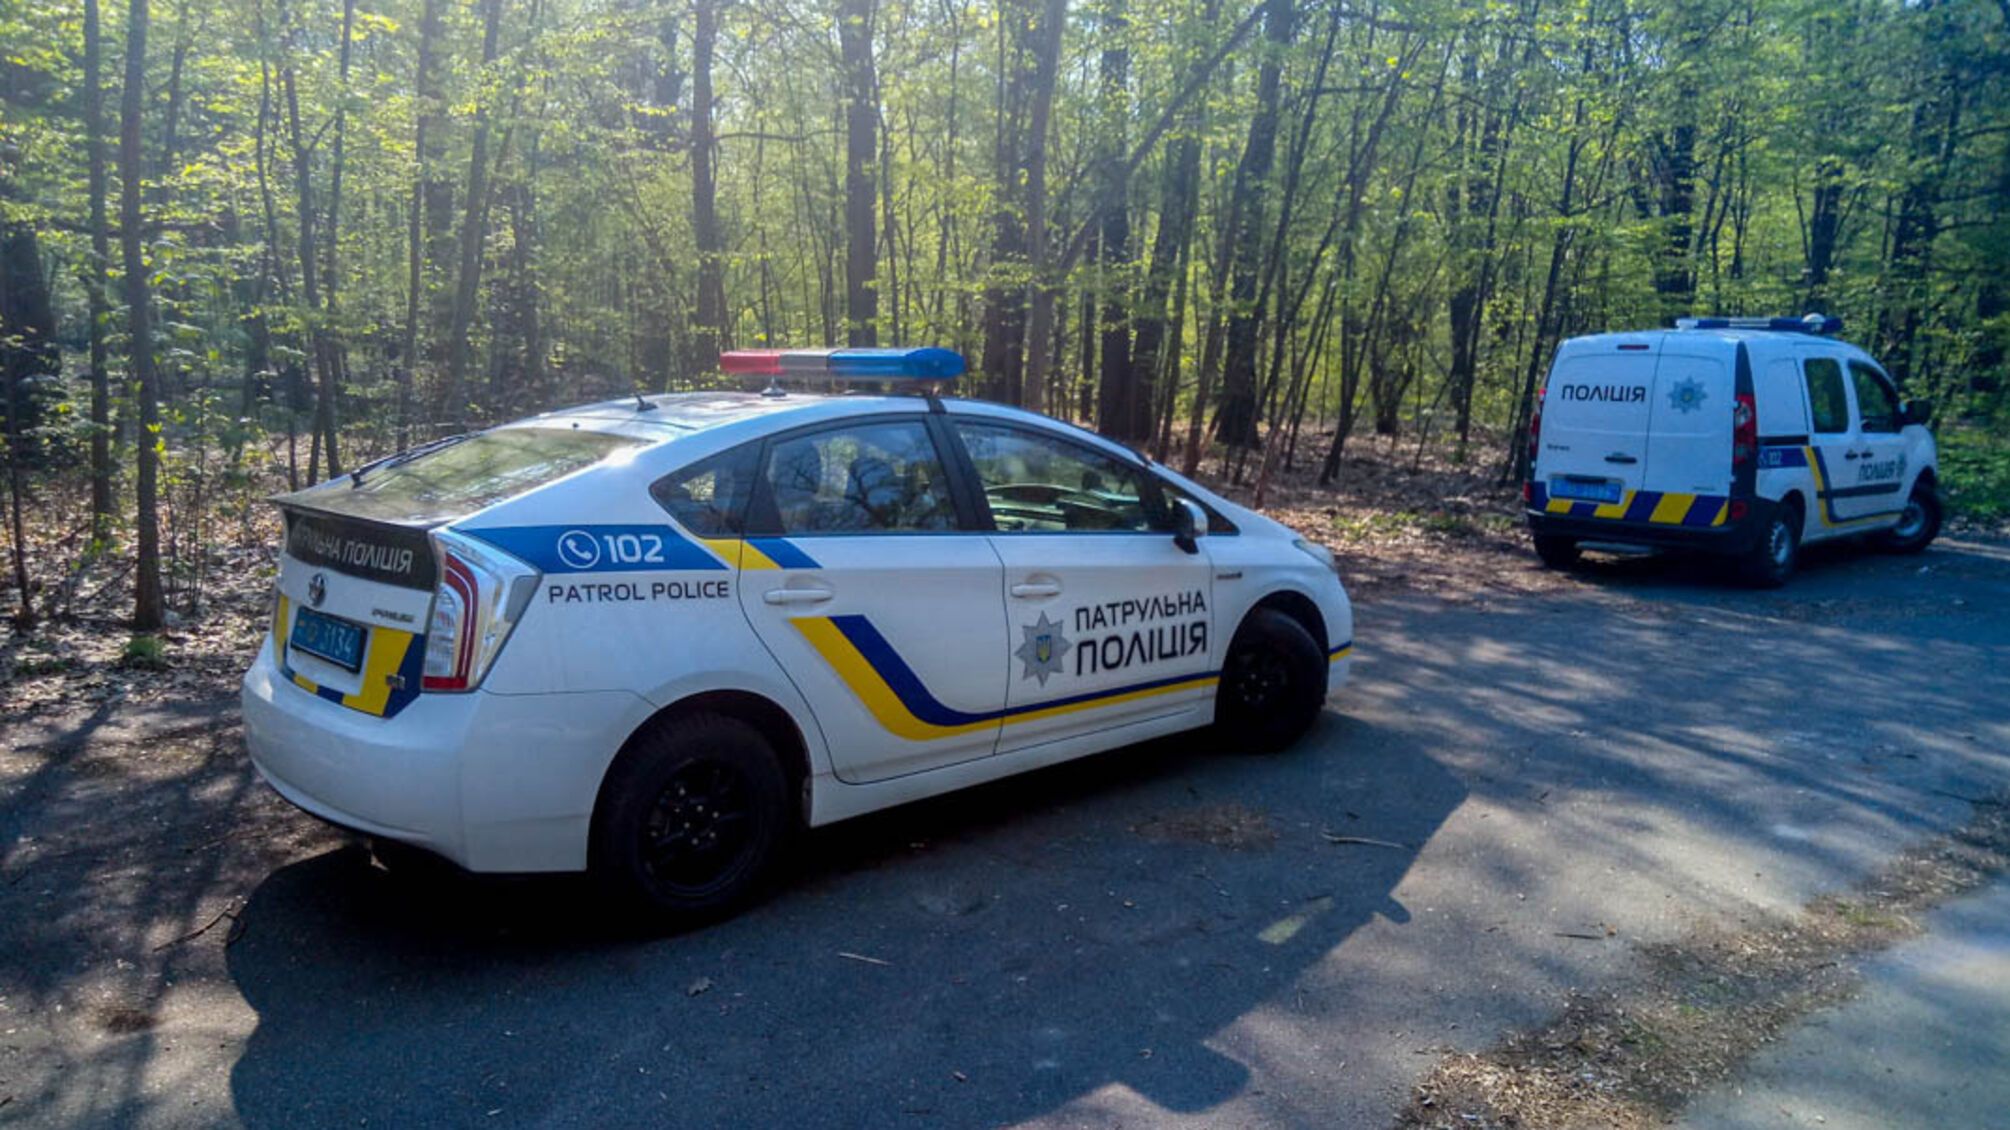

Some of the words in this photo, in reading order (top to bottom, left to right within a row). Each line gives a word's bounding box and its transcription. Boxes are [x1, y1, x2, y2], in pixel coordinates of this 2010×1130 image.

[1561, 383, 1646, 402] ПОЛІЦІЯ
[342, 540, 414, 574] ПОЛІЦІЯ
[603, 534, 665, 564] 102
[549, 582, 646, 604] PATROL
[651, 580, 730, 600] POLICE
[1075, 589, 1208, 633] ПАТРУЛЬНА
[1076, 620, 1208, 677] ПОЛІЦІЯ
